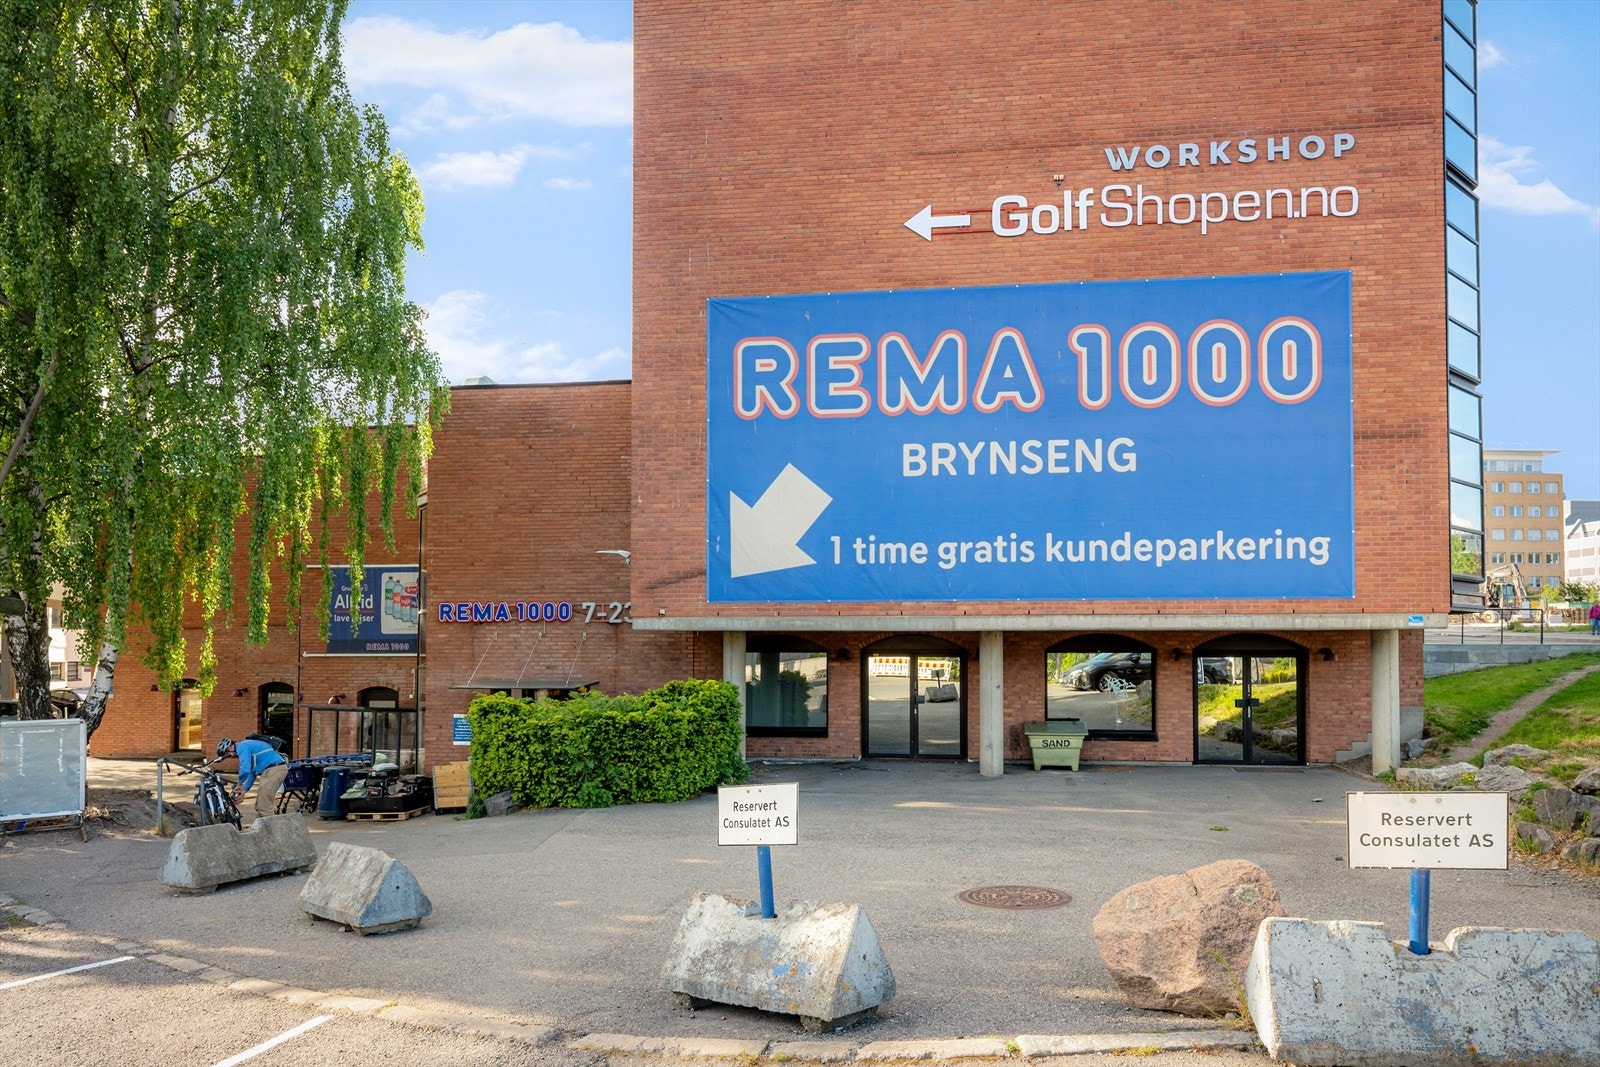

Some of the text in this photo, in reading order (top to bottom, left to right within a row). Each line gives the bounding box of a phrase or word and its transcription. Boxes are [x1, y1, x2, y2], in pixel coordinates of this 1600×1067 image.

[1104, 133, 1356, 171] WORKSHOP
[991, 184, 1359, 235] GolfShopen.no
[733, 316, 1322, 420] REMA 1000
[902, 437, 1137, 477] BRYNSENG
[830, 529, 1331, 570] 1 time gratis kundeparkering
[334, 614, 350, 622] lave
[438, 601, 512, 623] REMA
[516, 601, 573, 622] 1000
[365, 642, 410, 651] REMA 1000
[1042, 739, 1071, 748] SAND
[733, 800, 777, 812] Reservert
[723, 816, 790, 828] Consulatet AS
[1381, 812, 1473, 826] Reservert
[1360, 833, 1494, 848] Consulatet AS
